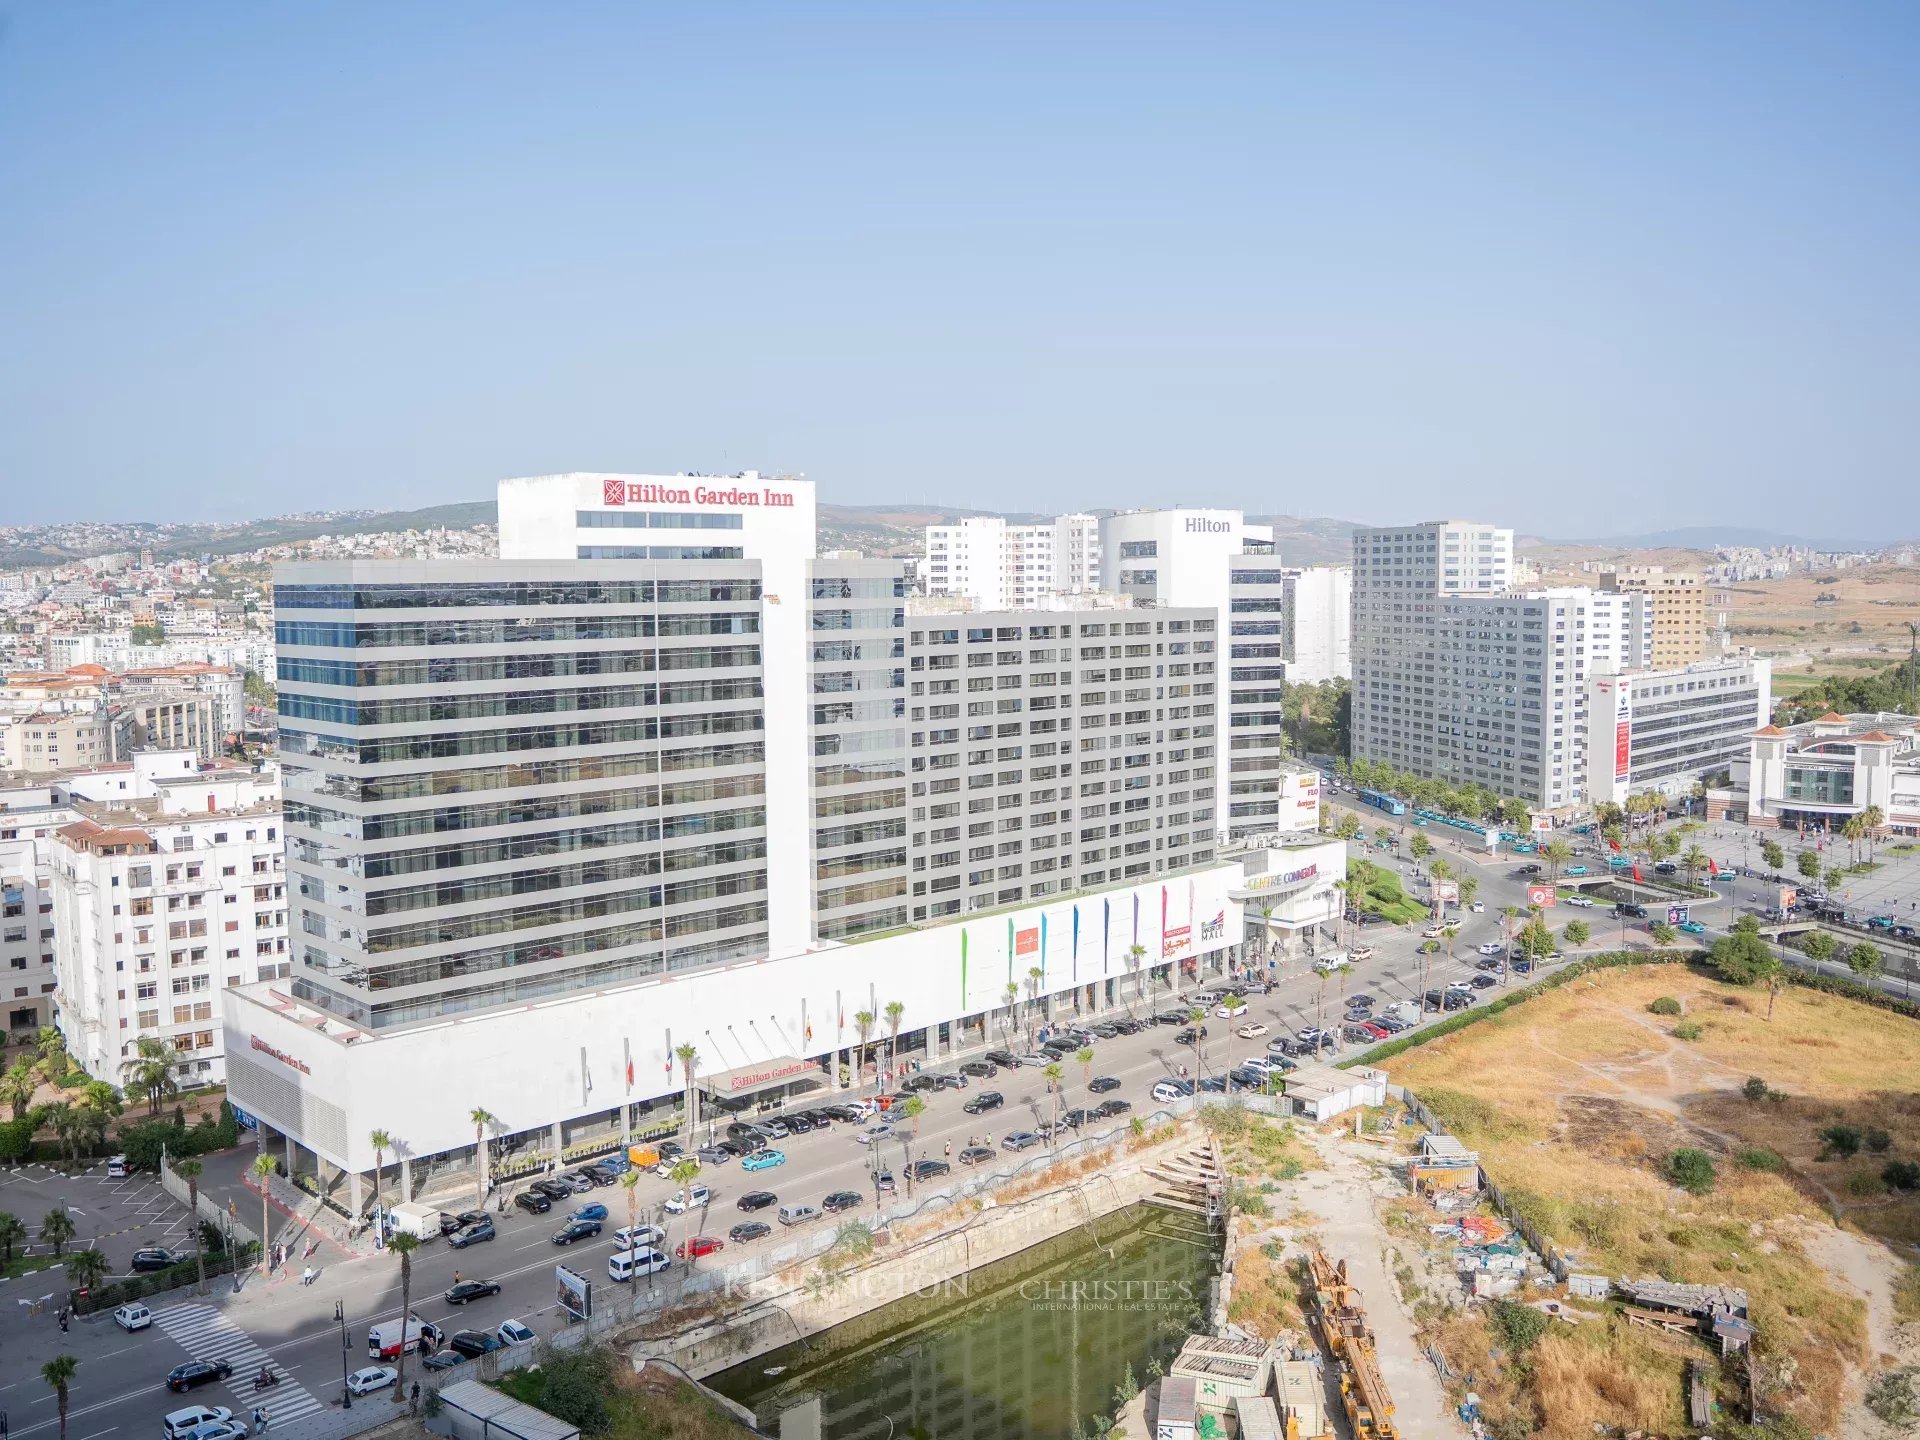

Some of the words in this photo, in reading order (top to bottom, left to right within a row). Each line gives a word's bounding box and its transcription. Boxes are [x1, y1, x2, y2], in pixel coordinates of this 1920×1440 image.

[627, 484, 691, 504] Hilton
[694, 486, 760, 506] Garden
[763, 488, 794, 507] Inn
[1185, 517, 1231, 532] Hilton
[1201, 929, 1225, 942] MALL
[277, 1049, 298, 1069] Garden
[298, 1059, 312, 1076] Inn
[741, 1073, 771, 1086] Hilton
[771, 1064, 802, 1079] Garden
